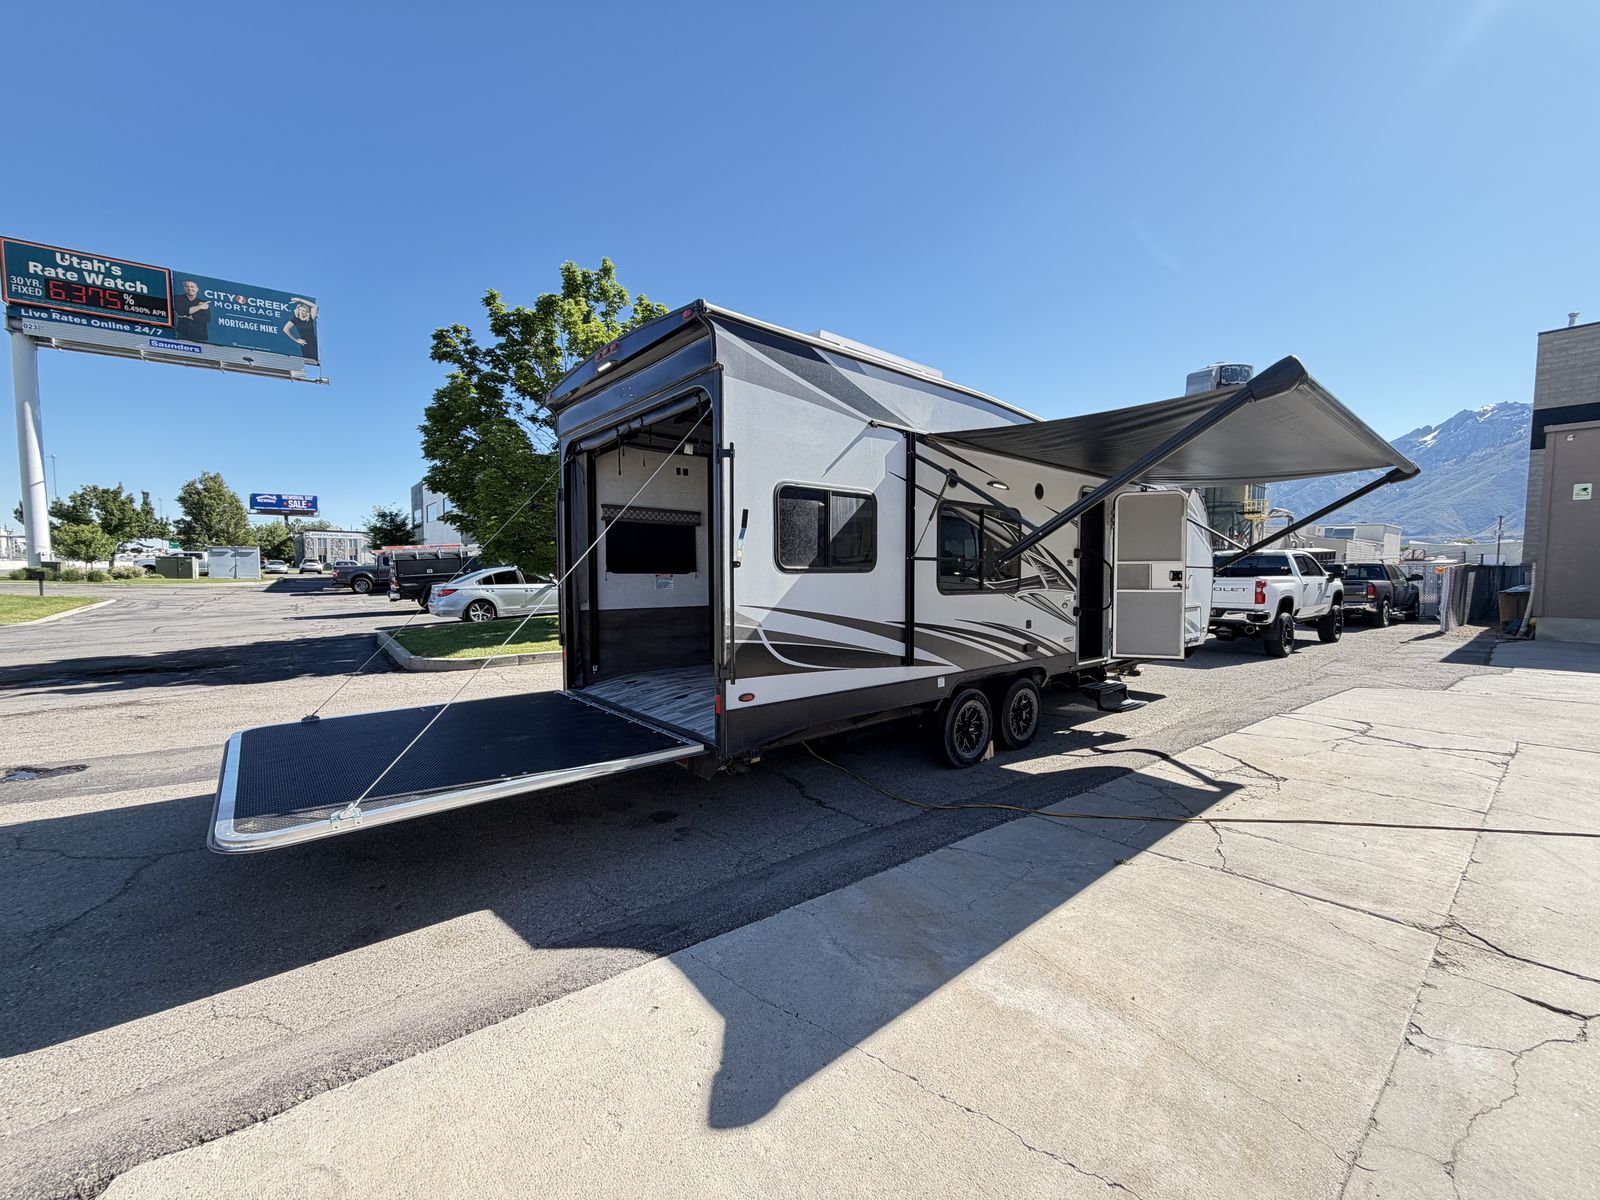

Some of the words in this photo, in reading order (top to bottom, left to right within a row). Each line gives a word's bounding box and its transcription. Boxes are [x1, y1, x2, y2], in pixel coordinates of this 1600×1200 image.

[56, 252, 123, 276] Utah's
[10, 275, 24, 285] 30
[23, 277, 43, 288] YR.
[28, 261, 78, 281] Rate
[82, 271, 148, 294] Watch
[11, 284, 43, 297] FIXED
[49, 281, 121, 308] 6.375
[122, 293, 135, 305] %
[204, 289, 236, 302] CITY
[247, 297, 289, 312] CREEK
[214, 300, 281, 318] MORTGAGE
[152, 309, 167, 317] APR
[20, 308, 48, 319] Live
[52, 312, 88, 325] Rates
[91, 318, 130, 331] Online
[134, 325, 163, 336] 24/7
[218, 317, 259, 332] MORTGAGE
[259, 324, 279, 334] MIKE
[150, 340, 201, 353] Saunders
[287, 500, 307, 508] SALE
